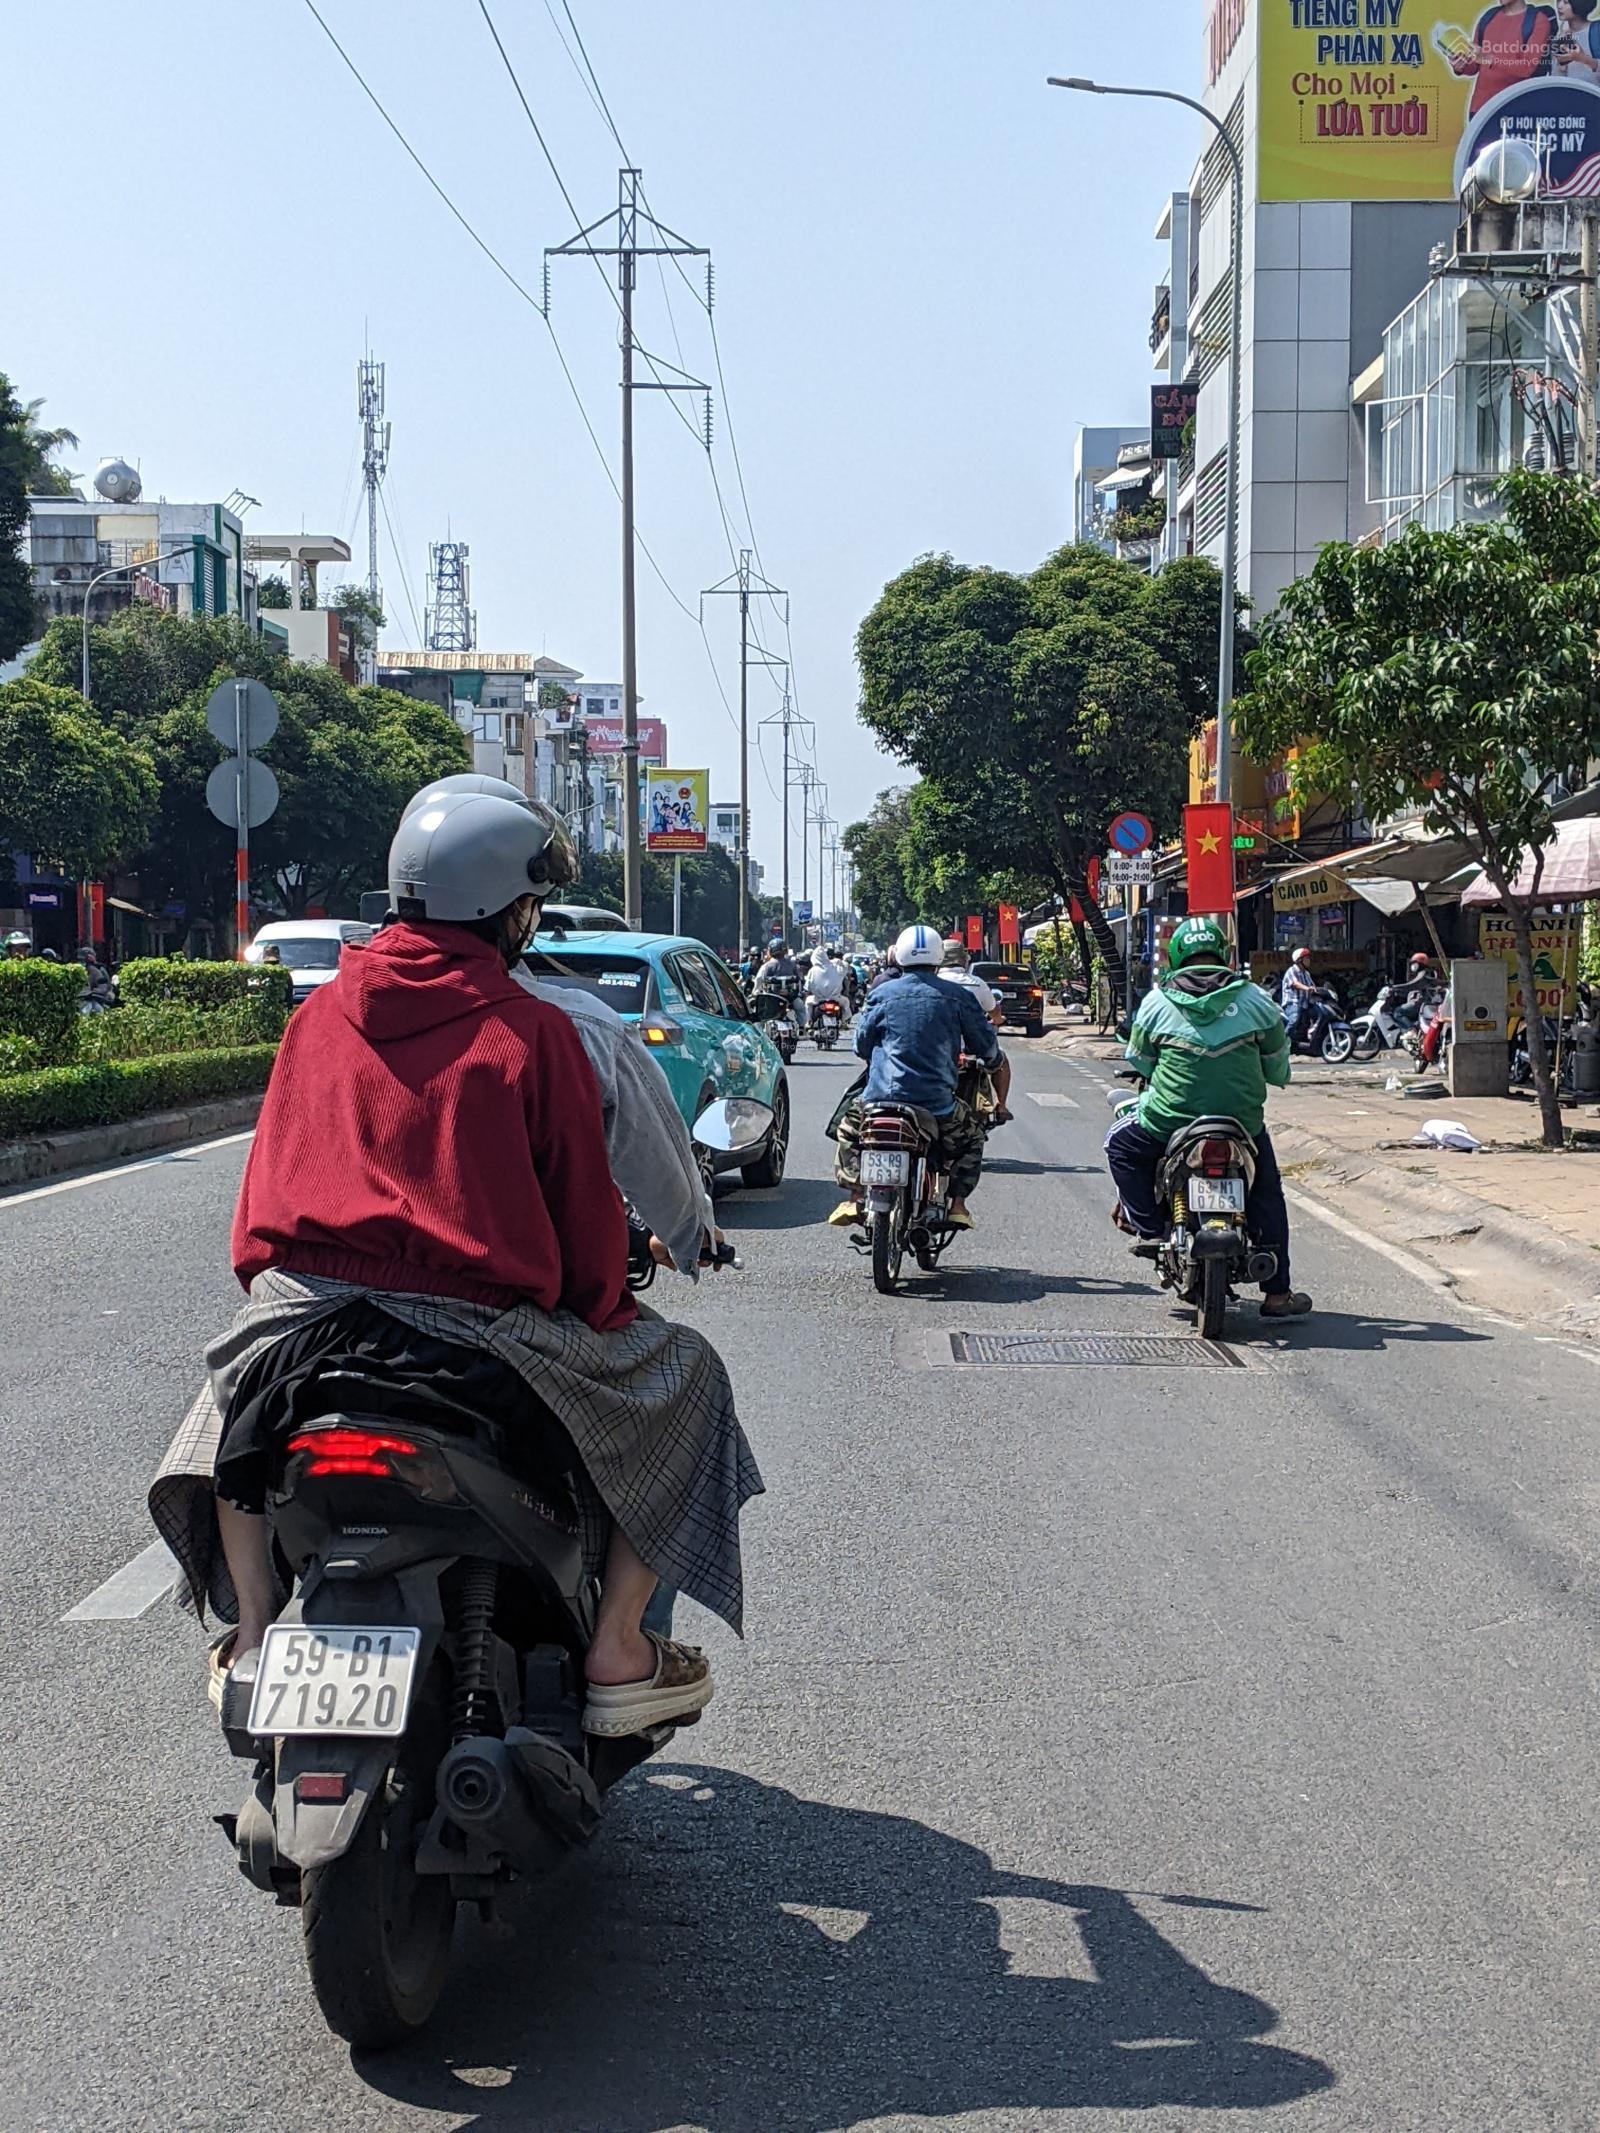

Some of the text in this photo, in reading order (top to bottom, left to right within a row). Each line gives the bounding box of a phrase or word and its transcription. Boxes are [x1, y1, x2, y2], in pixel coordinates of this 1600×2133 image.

[1291, 72, 1395, 100] Cho Mọi
[1368, 95, 1428, 136] TUỔI
[1562, 131, 1585, 152] MỸ
[1184, 931, 1216, 945] Grab
[1198, 1181, 1233, 1194] 63-N1
[342, 1526, 389, 1535] HONDA
[284, 1635, 391, 1678] 59-B1
[262, 1682, 398, 1728] 719.20
